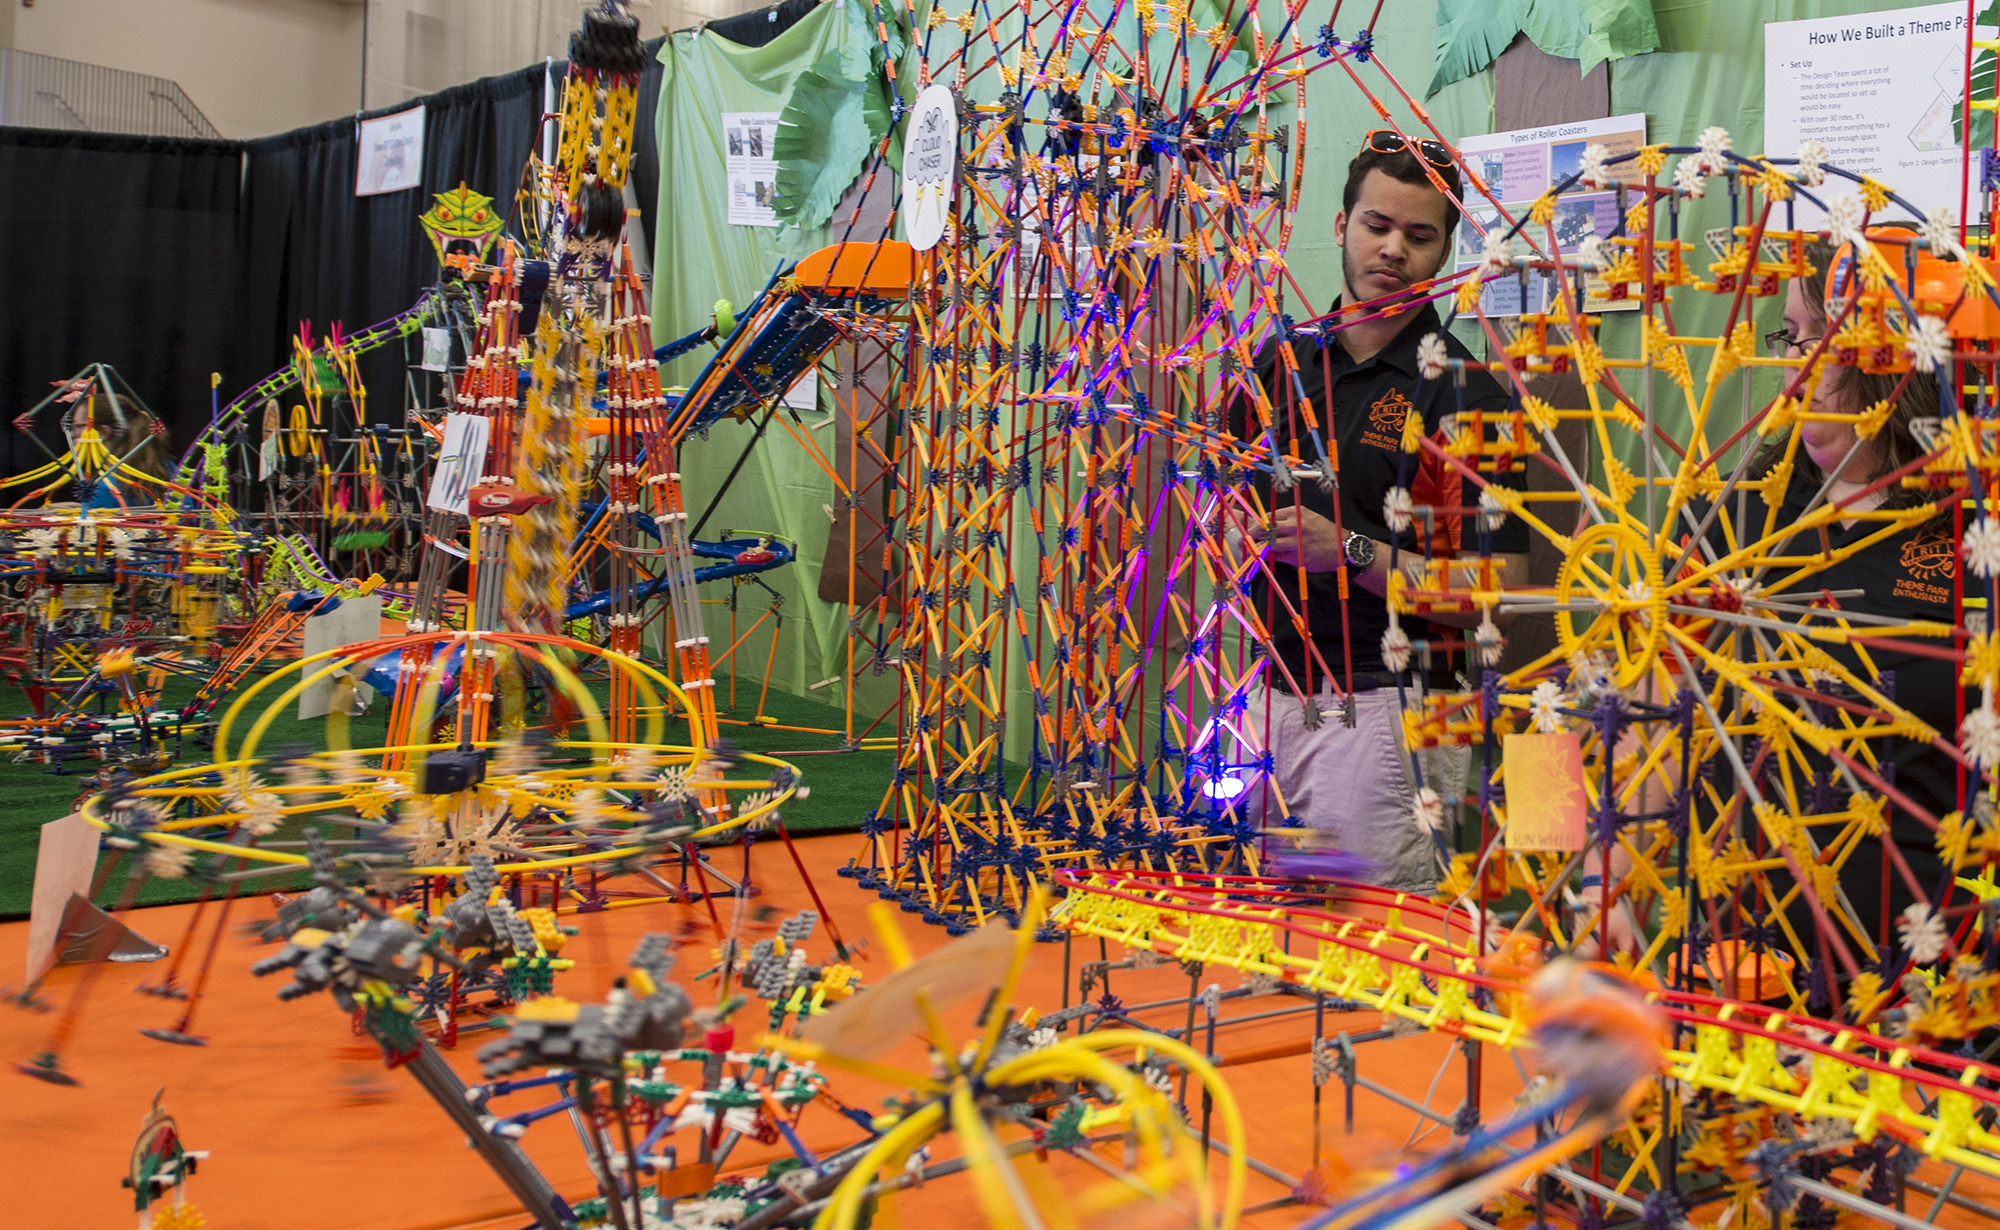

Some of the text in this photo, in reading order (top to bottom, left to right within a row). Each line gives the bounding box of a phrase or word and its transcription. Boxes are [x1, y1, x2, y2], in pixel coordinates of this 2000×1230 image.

[1809, 12, 1979, 45] How We Built a Theme Pa
[1803, 60, 1813, 68] Up
[1813, 72, 1832, 80] Design
[1833, 70, 1849, 78] Team
[1850, 69, 1867, 77] spent
[1815, 82, 1839, 90] deciding
[1860, 78, 1891, 87] everything
[1828, 91, 1850, 99] located
[1510, 126, 1587, 144] Types of Roller Coasters
[1800, 126, 1829, 134] important
[1843, 123, 1874, 131] everything
[922, 135, 941, 152] CLOUD
[1837, 134, 1859, 143] enough
[919, 153, 941, 171] CHASER
[1898, 160, 1914, 168] Figure
[1382, 406, 1399, 414] RIT
[1360, 437, 1397, 453] ENTHUSIASTS
[1363, 430, 1399, 446] THEME PARK
[1920, 544, 1942, 557] RIT
[1896, 579, 1951, 597] THEME PARK
[1893, 588, 1948, 604] ENTHUSIASTS
[1513, 832, 1577, 847] SUN WHEEL
